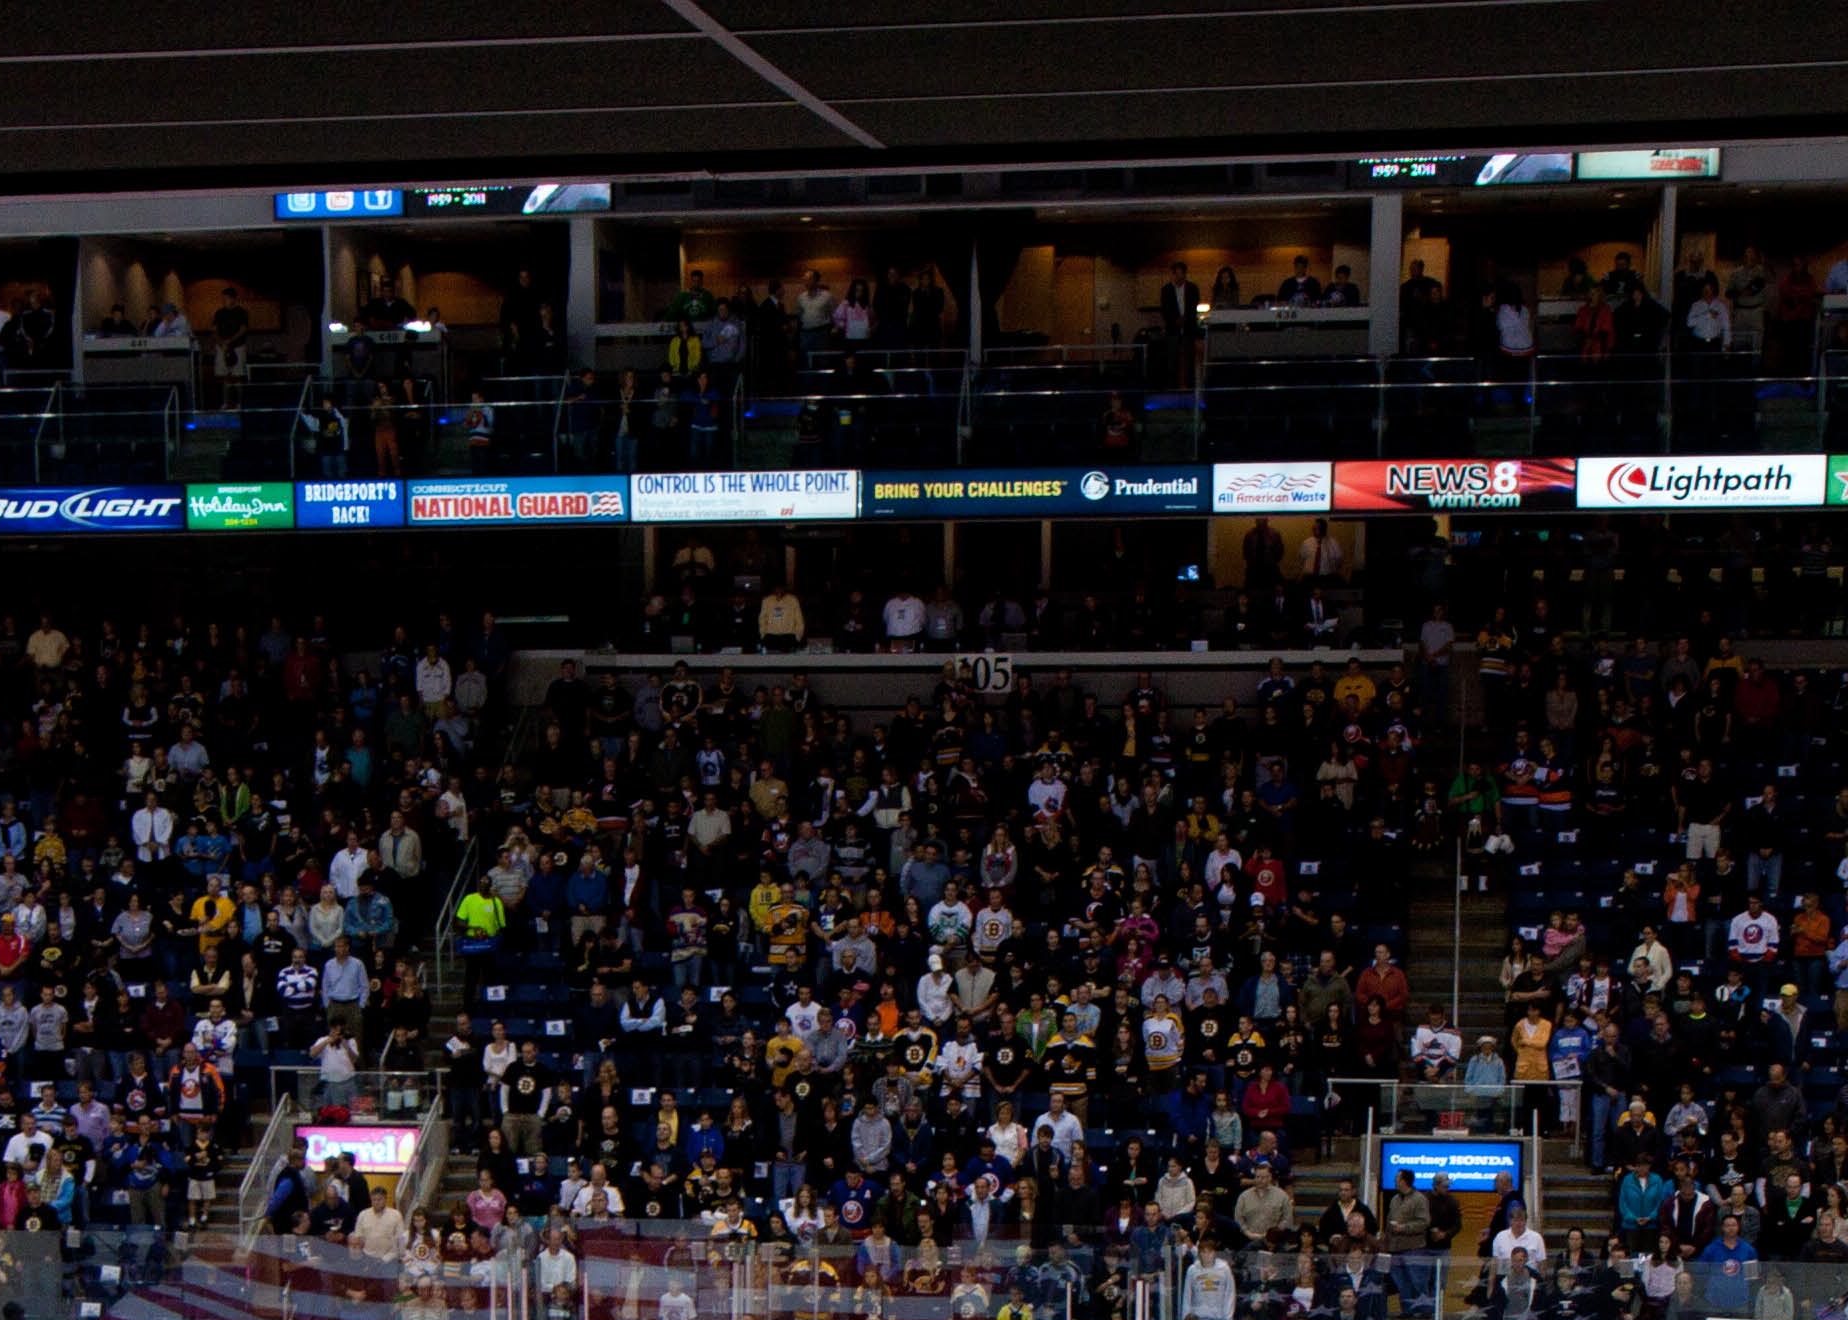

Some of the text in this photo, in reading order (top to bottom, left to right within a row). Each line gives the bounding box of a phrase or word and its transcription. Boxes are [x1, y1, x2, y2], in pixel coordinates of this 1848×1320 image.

[637, 471, 850, 494] CONTROL IS THE WHOLE POINT.
[1115, 478, 1198, 496] Prudential
[1388, 462, 1517, 494] NEWS 8
[1651, 464, 1792, 501] Lightpath
[305, 483, 397, 503] BRIDGEPORT'S
[874, 481, 1062, 499] BRING YOUR CHALLENGES
[1218, 492, 1326, 504] All American Waste
[75, 498, 180, 517] LIGHT
[189, 496, 287, 519] Holiday Inn
[412, 494, 589, 519] NATIONAL GUARD
[1429, 492, 1520, 510] wtnh.com
[332, 506, 369, 524] BACK!
[963, 656, 1010, 690] 05
[304, 1134, 396, 1172] Carvel
[1390, 1154, 1513, 1168] Courtney HONDA
